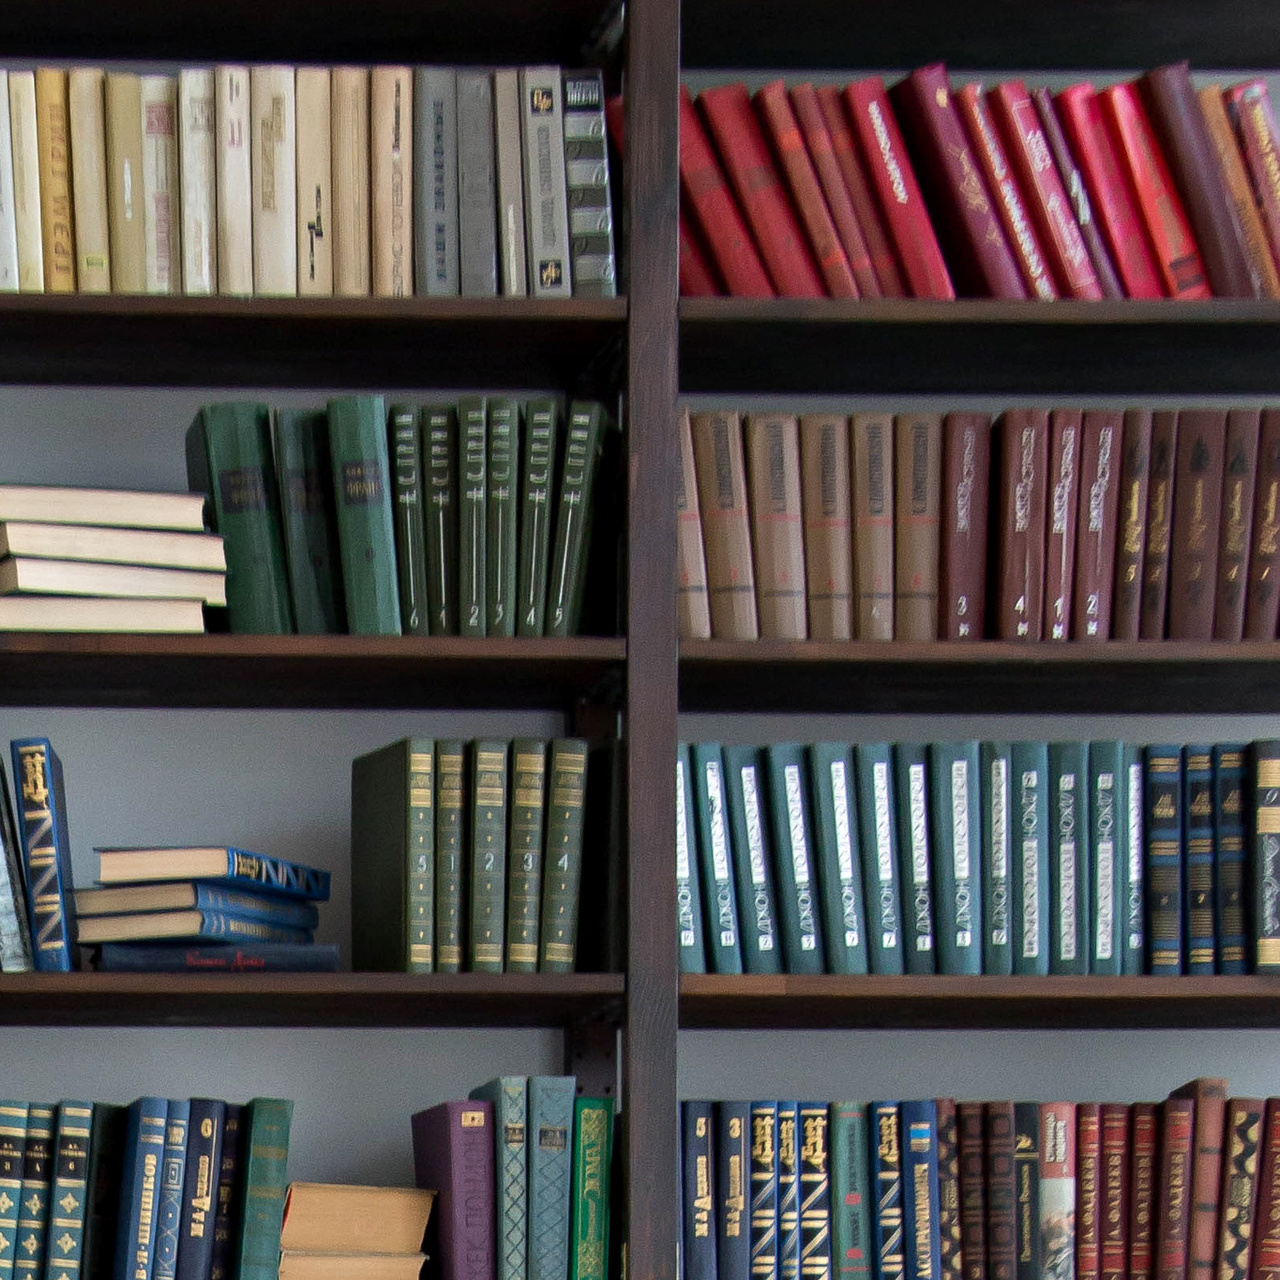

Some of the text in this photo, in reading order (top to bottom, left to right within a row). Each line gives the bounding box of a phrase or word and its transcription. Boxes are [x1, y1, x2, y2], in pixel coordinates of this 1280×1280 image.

[469, 604, 479, 626] 2
[484, 852, 494, 871] 2
[523, 853, 534, 872] 3
[558, 854, 570, 872] 4
